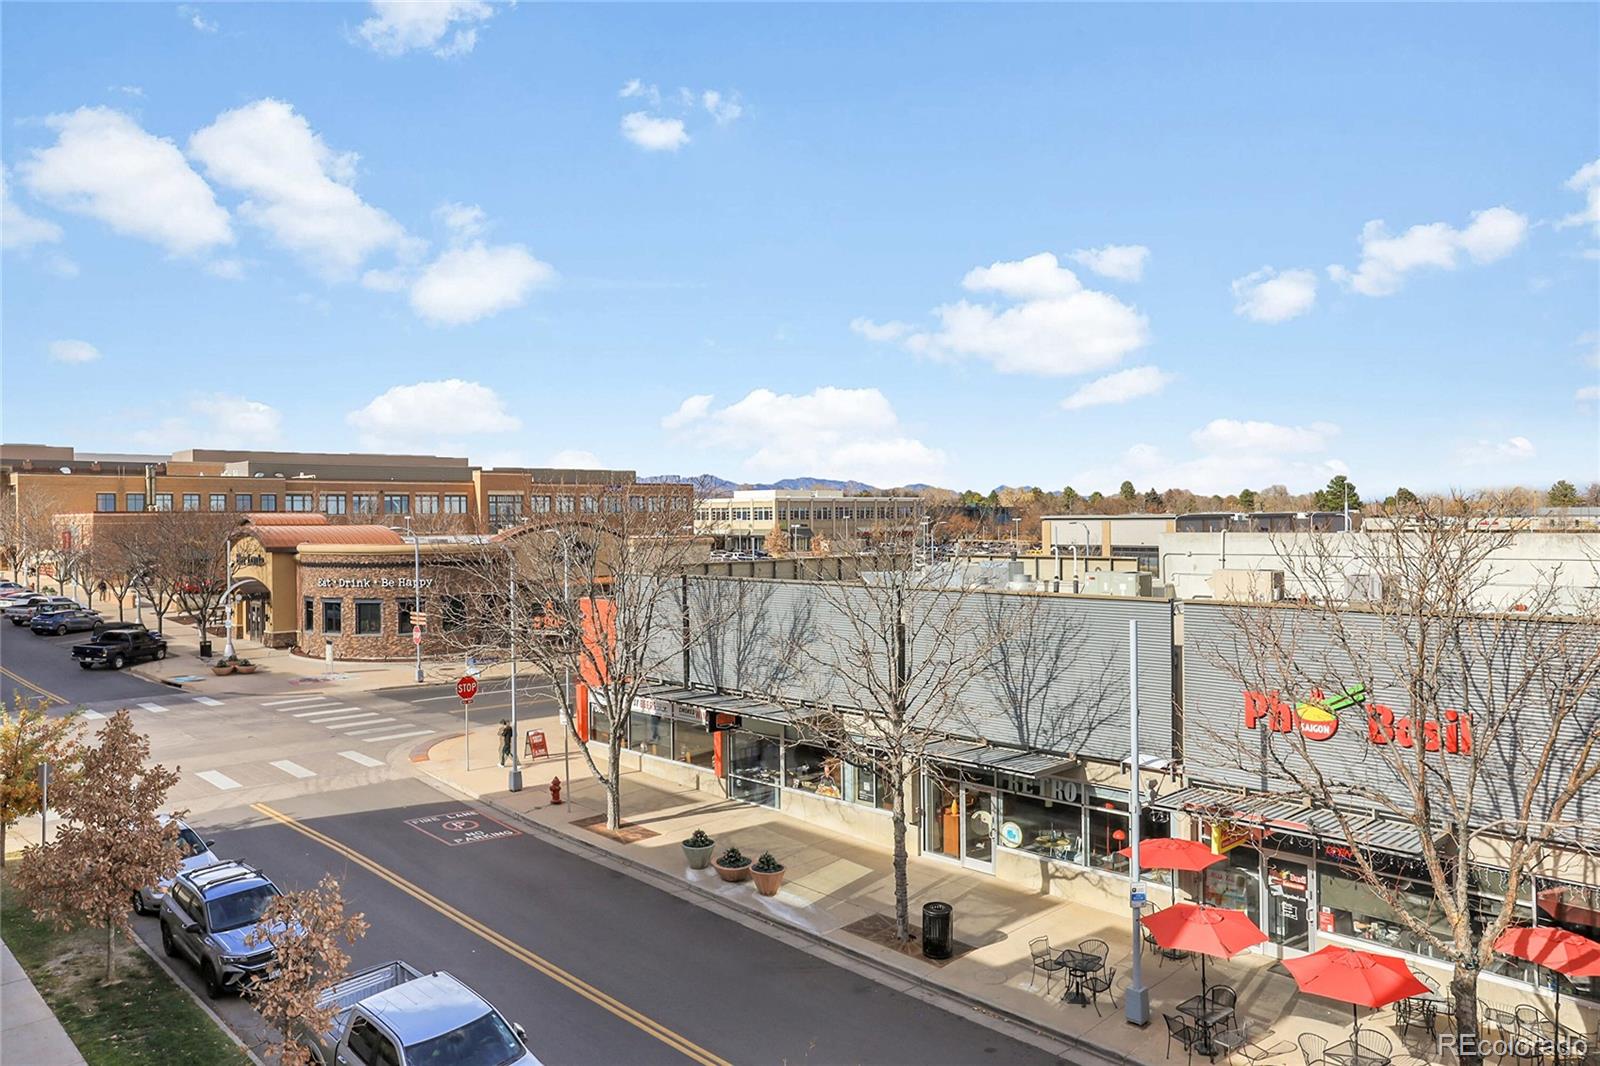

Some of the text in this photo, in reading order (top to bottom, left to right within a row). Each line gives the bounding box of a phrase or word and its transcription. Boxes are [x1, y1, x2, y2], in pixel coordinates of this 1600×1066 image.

[318, 578, 432, 588] Eat Drink Be Happy
[458, 683, 477, 694] STOP
[1300, 722, 1330, 735] SAIGON
[1366, 703, 1473, 756] Basil
[1007, 774, 1077, 802] RETRO
[411, 811, 479, 825] FIRE LANE
[453, 830, 514, 844] PARKING
